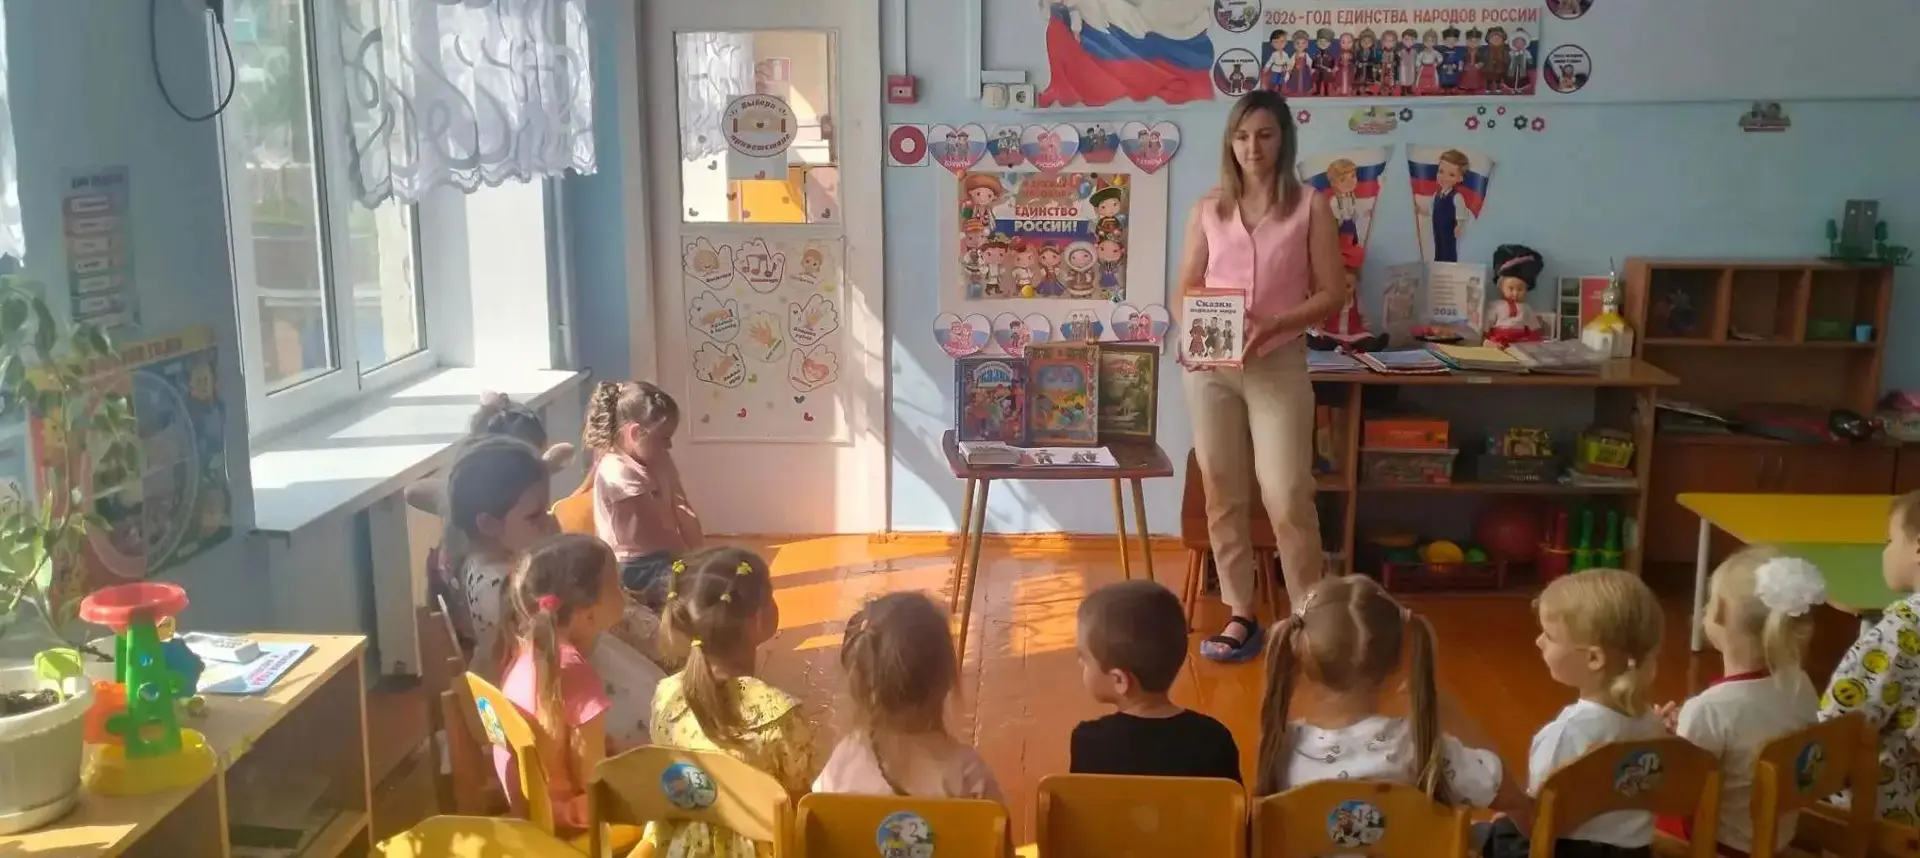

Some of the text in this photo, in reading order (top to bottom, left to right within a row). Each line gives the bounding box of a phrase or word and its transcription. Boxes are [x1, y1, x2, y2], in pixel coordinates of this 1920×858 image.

[1264, 7, 1538, 26] 2026-ГОД ЕДИНСТВА НАРОДОВ РОССИИ
[731, 99, 791, 151] Выбери приветствие
[1015, 206, 1078, 218] ЕДИНСТВО
[1014, 220, 1078, 232] РОССИИ!
[1195, 299, 1232, 308] Сказки
[908, 821, 918, 838] 2
